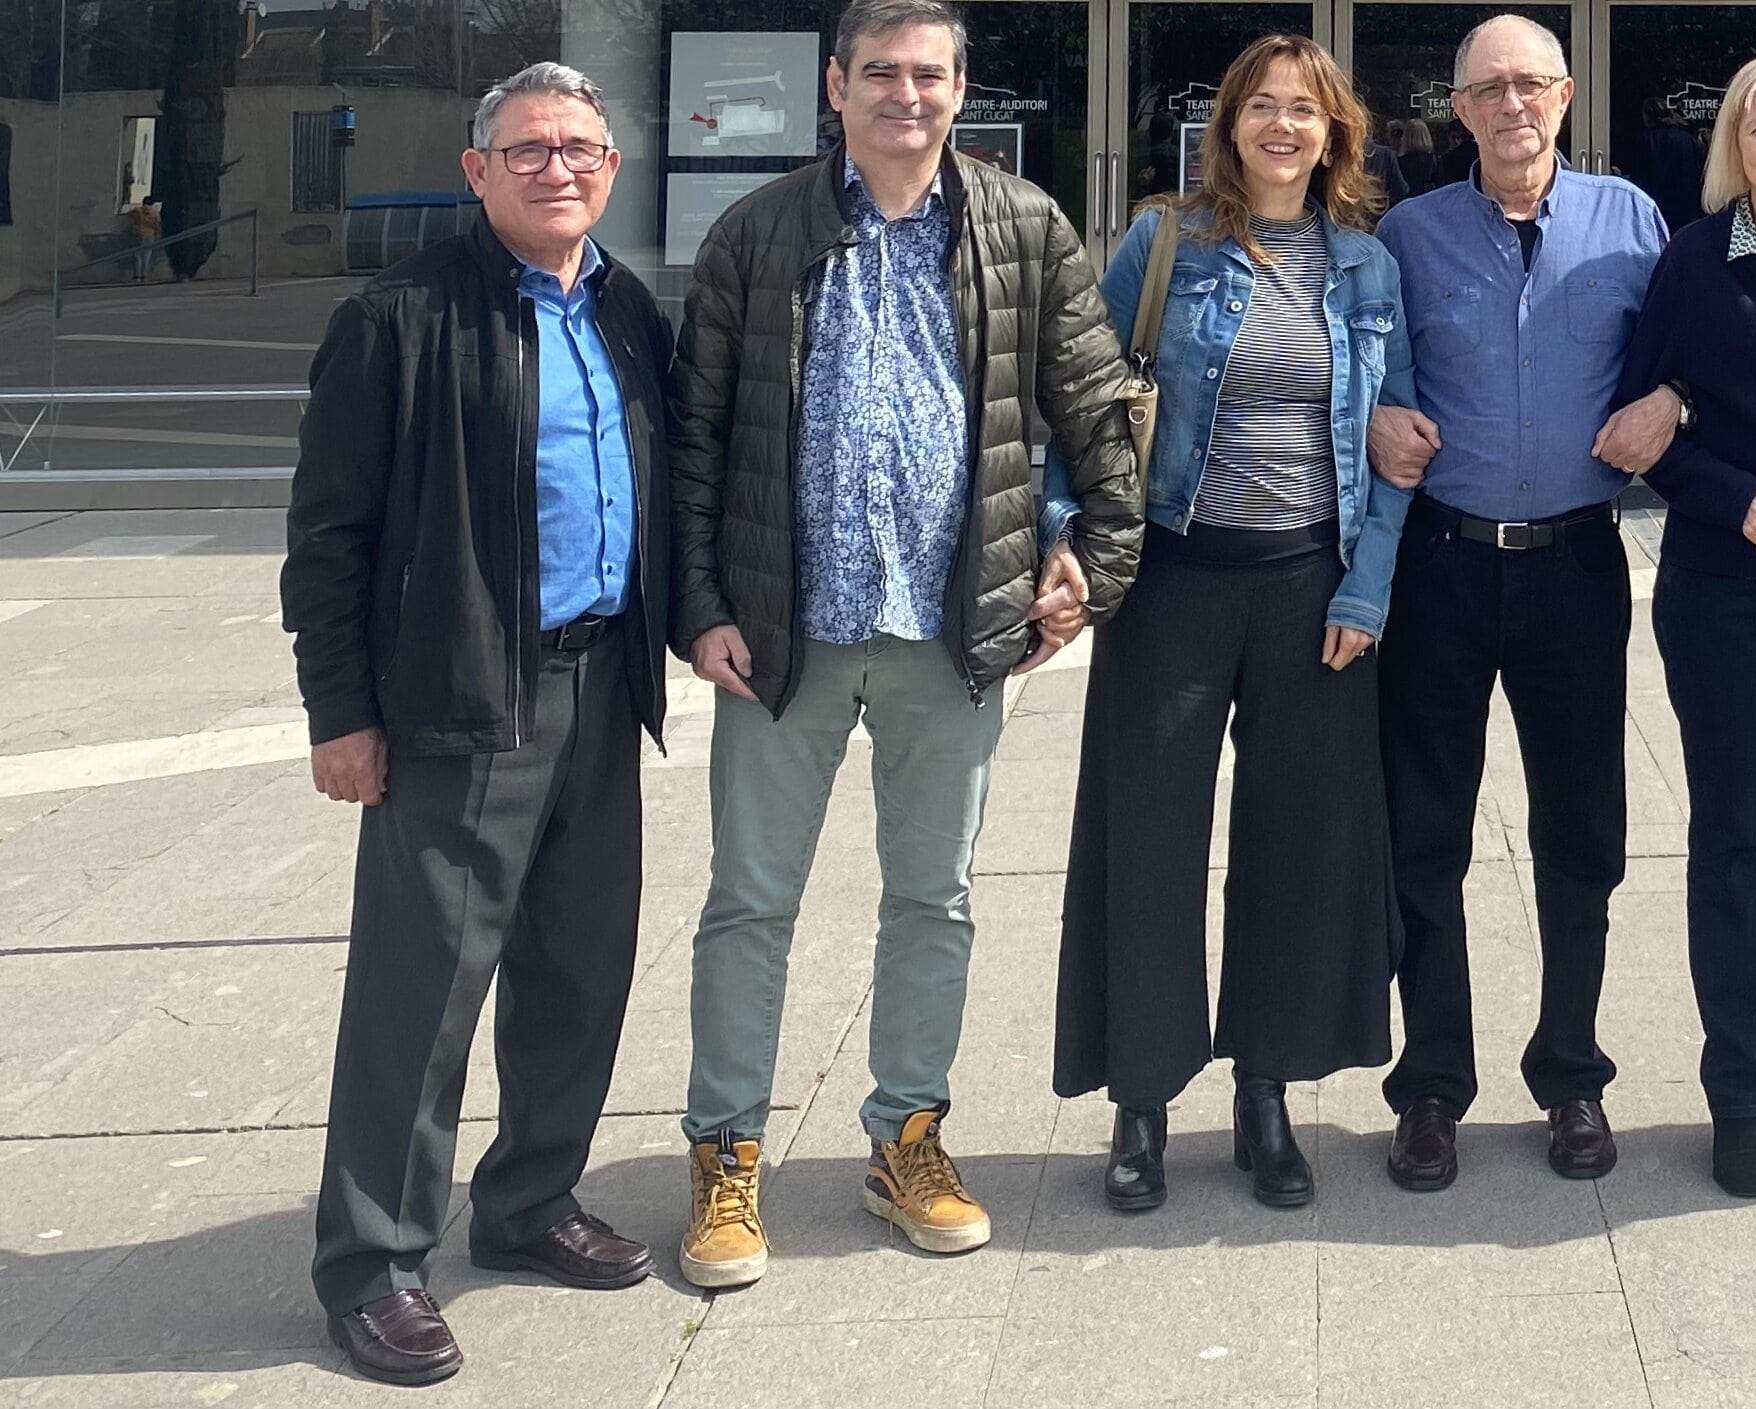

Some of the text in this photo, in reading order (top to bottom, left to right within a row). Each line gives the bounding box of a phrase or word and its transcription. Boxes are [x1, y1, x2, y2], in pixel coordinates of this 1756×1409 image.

[963, 99, 1048, 111] EATRE-AUDITORI
[1427, 98, 1452, 108] TEAT
[1682, 98, 1722, 109] TEATRE-
[983, 110, 1014, 121] CUGAT
[1427, 109, 1452, 119] SANT
[1682, 109, 1706, 120] SANT
